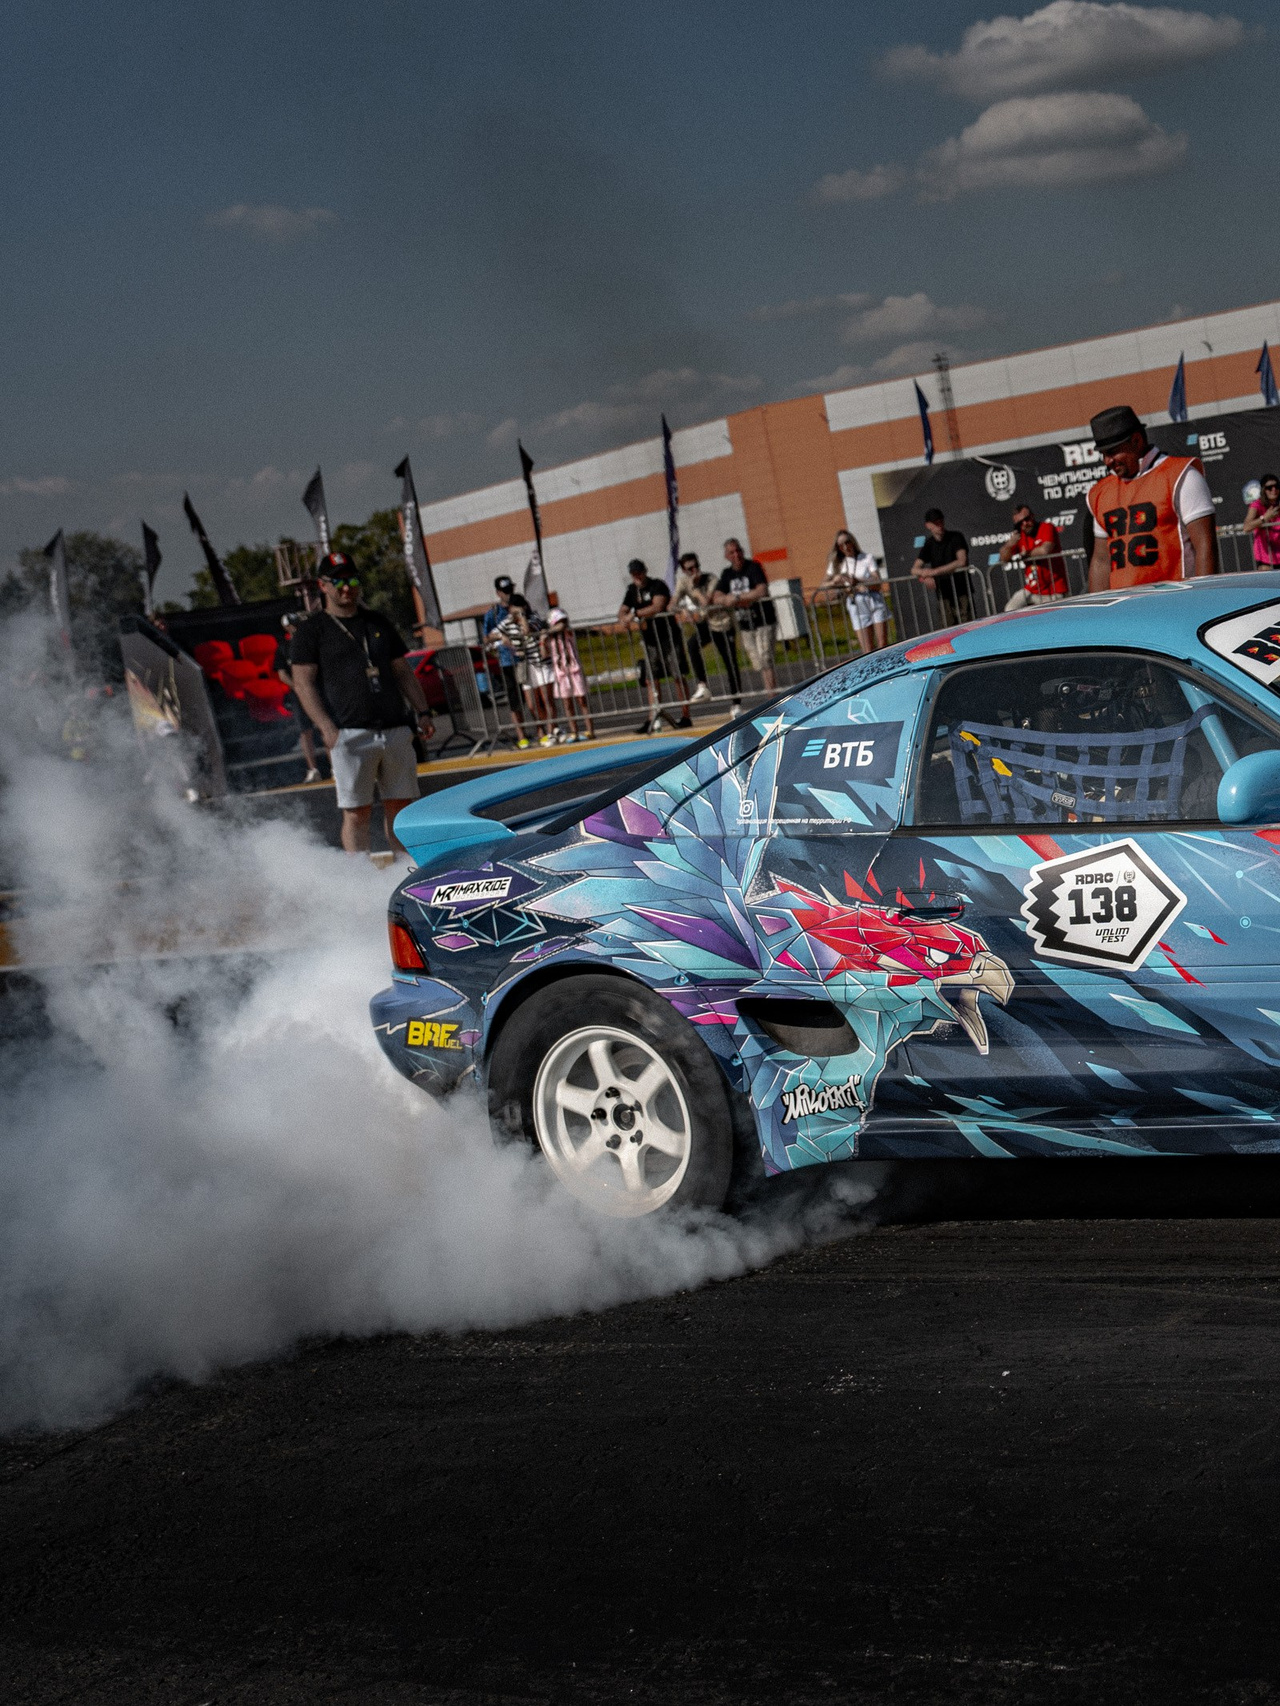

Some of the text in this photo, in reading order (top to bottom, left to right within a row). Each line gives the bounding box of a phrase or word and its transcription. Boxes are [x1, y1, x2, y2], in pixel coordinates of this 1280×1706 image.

[1199, 431, 1227, 450] ВТБ
[1037, 465, 1108, 488] ЧЕМПИОНА
[1043, 486, 1063, 500] ПО
[1103, 501, 1158, 538] RD
[823, 741, 875, 769] ВТБ
[1075, 872, 1114, 885] RDRC
[1068, 886, 1137, 925] 138
[1095, 927, 1129, 937] UNLIM
[1101, 934, 1127, 943] FEST
